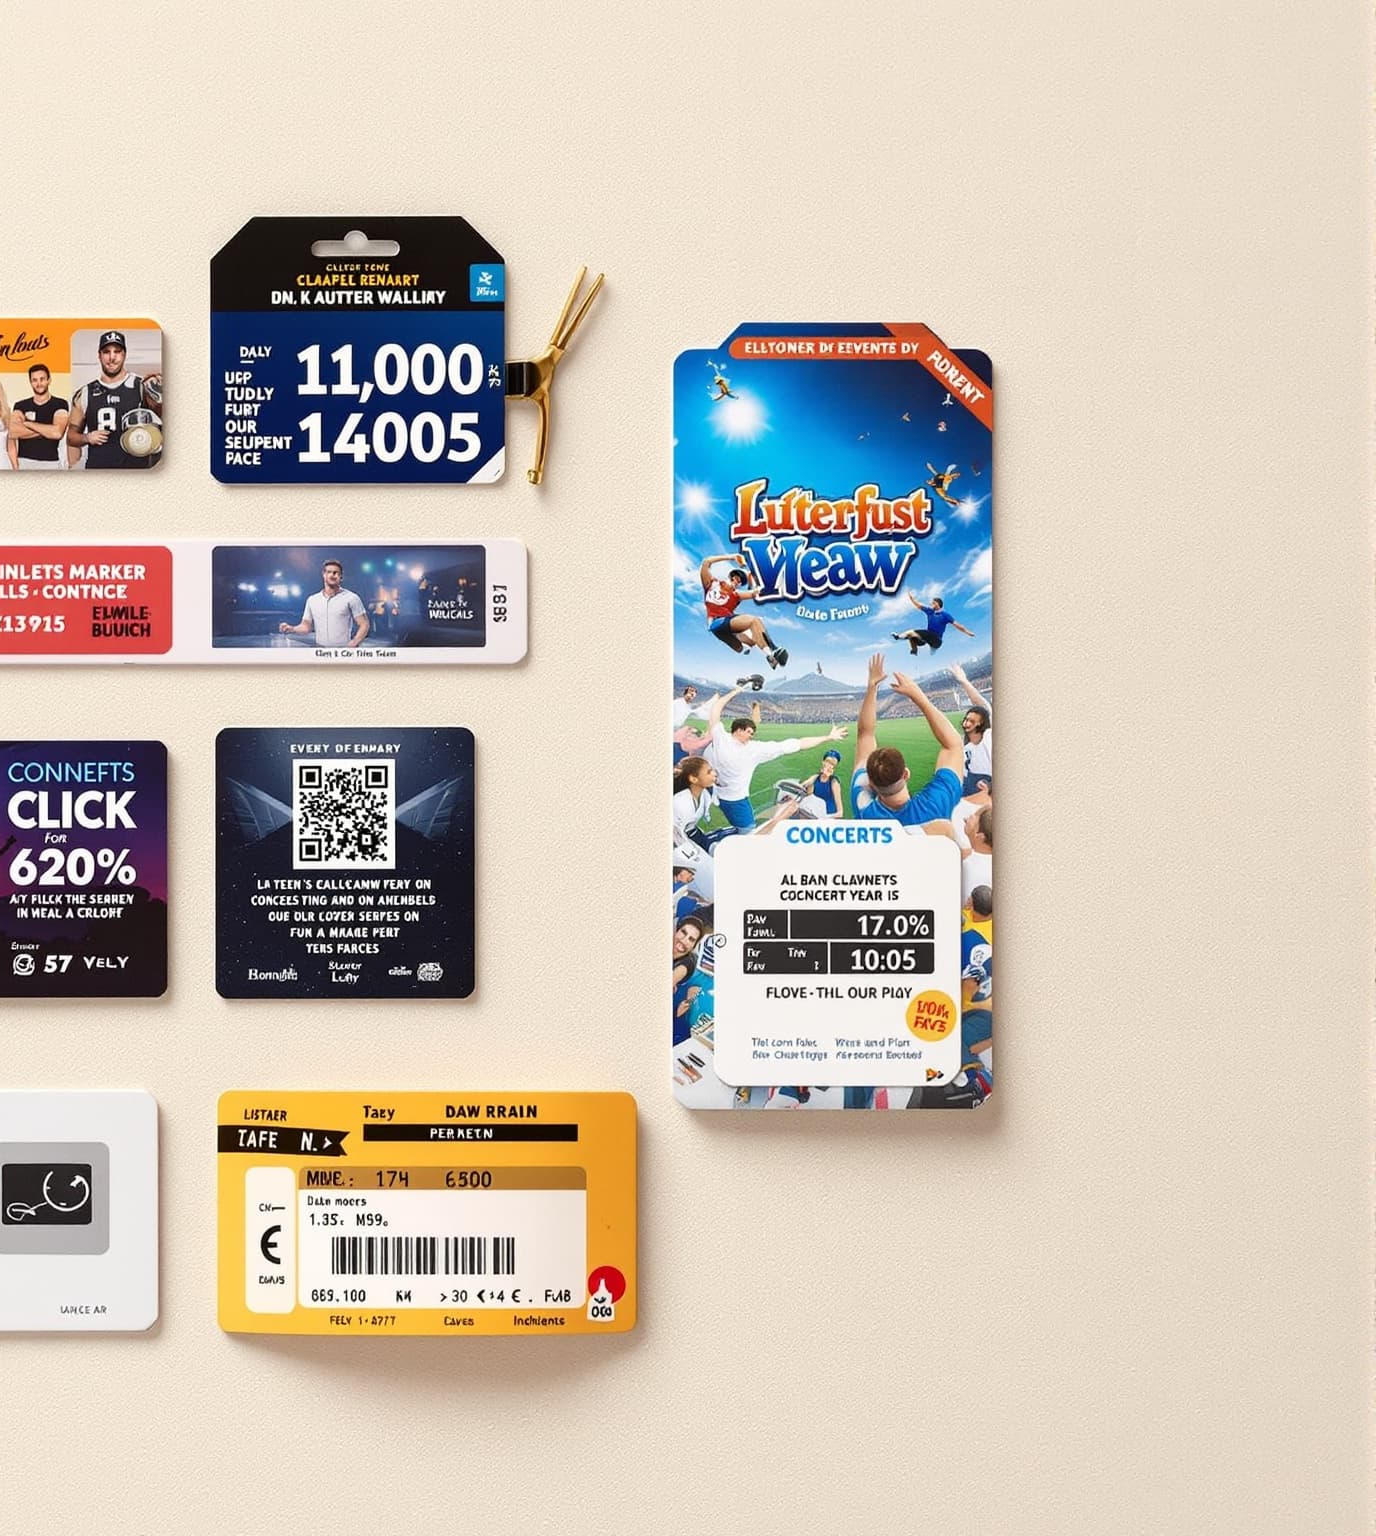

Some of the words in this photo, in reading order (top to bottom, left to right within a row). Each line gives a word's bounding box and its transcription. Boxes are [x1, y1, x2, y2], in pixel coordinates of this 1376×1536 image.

[314, 290, 374, 305] AUTTER
[239, 345, 273, 358] DALY
[296, 343, 484, 403] 11,000
[224, 387, 275, 401] TUDLY
[225, 419, 257, 434] OUR
[224, 435, 293, 450] SEUPENT
[297, 411, 483, 464] 14005
[225, 451, 262, 465] PACE
[69, 564, 146, 581] MARKER
[7, 761, 135, 783] CONNEFTS
[7, 790, 138, 829] CLICK
[786, 826, 894, 844] CONCERTS
[9, 847, 137, 887] 620%
[65, 894, 87, 905] THE
[850, 889, 883, 901] YEAR
[65, 907, 74, 919] A
[857, 915, 930, 936] 17.0%
[43, 954, 73, 974] 57
[851, 949, 916, 971] 10:05
[766, 986, 807, 999] FLOVE
[848, 986, 877, 999] OUR
[445, 1105, 482, 1118] DAW
[486, 1105, 538, 1118] RRAIN
